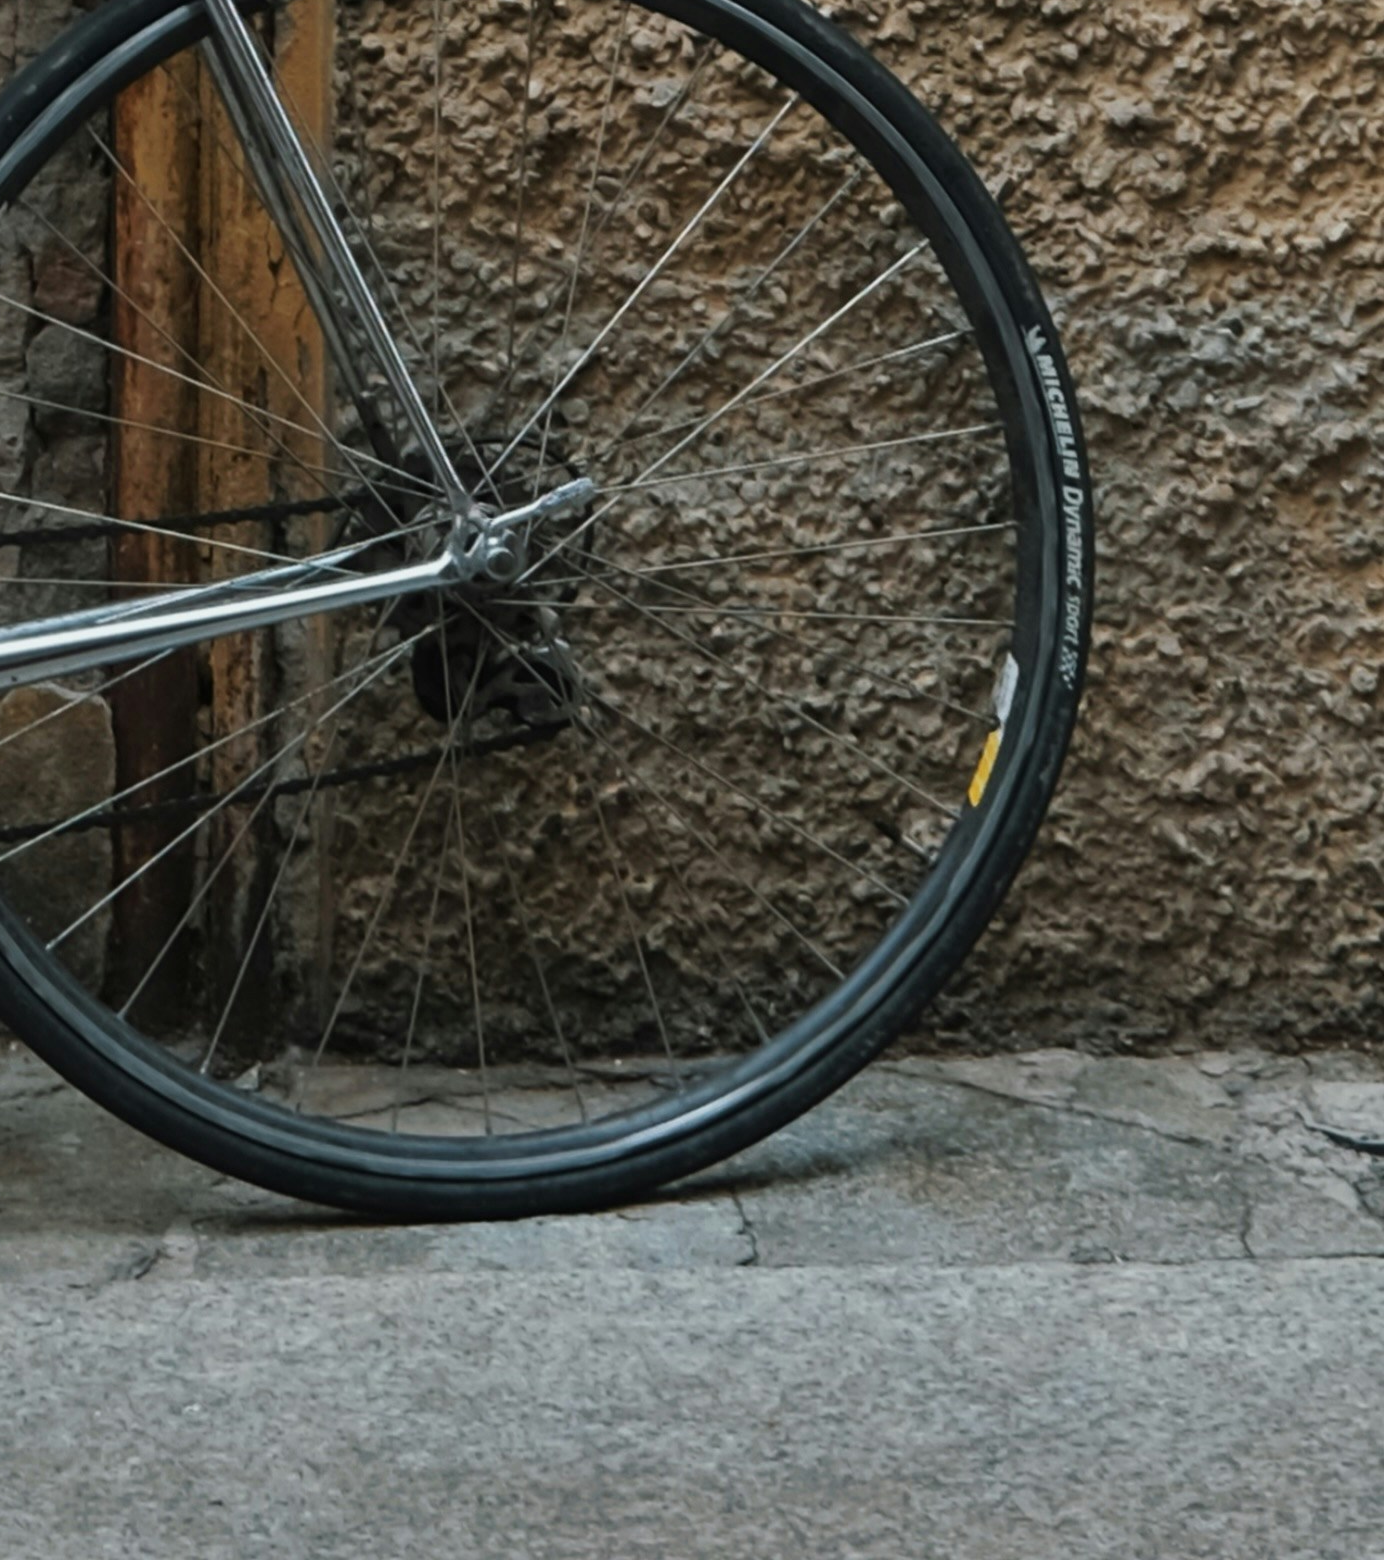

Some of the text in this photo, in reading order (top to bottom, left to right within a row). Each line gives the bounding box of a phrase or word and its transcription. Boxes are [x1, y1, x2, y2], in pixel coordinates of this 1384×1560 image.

[1036, 353, 1085, 646] MICHELIN Dynamic sport
